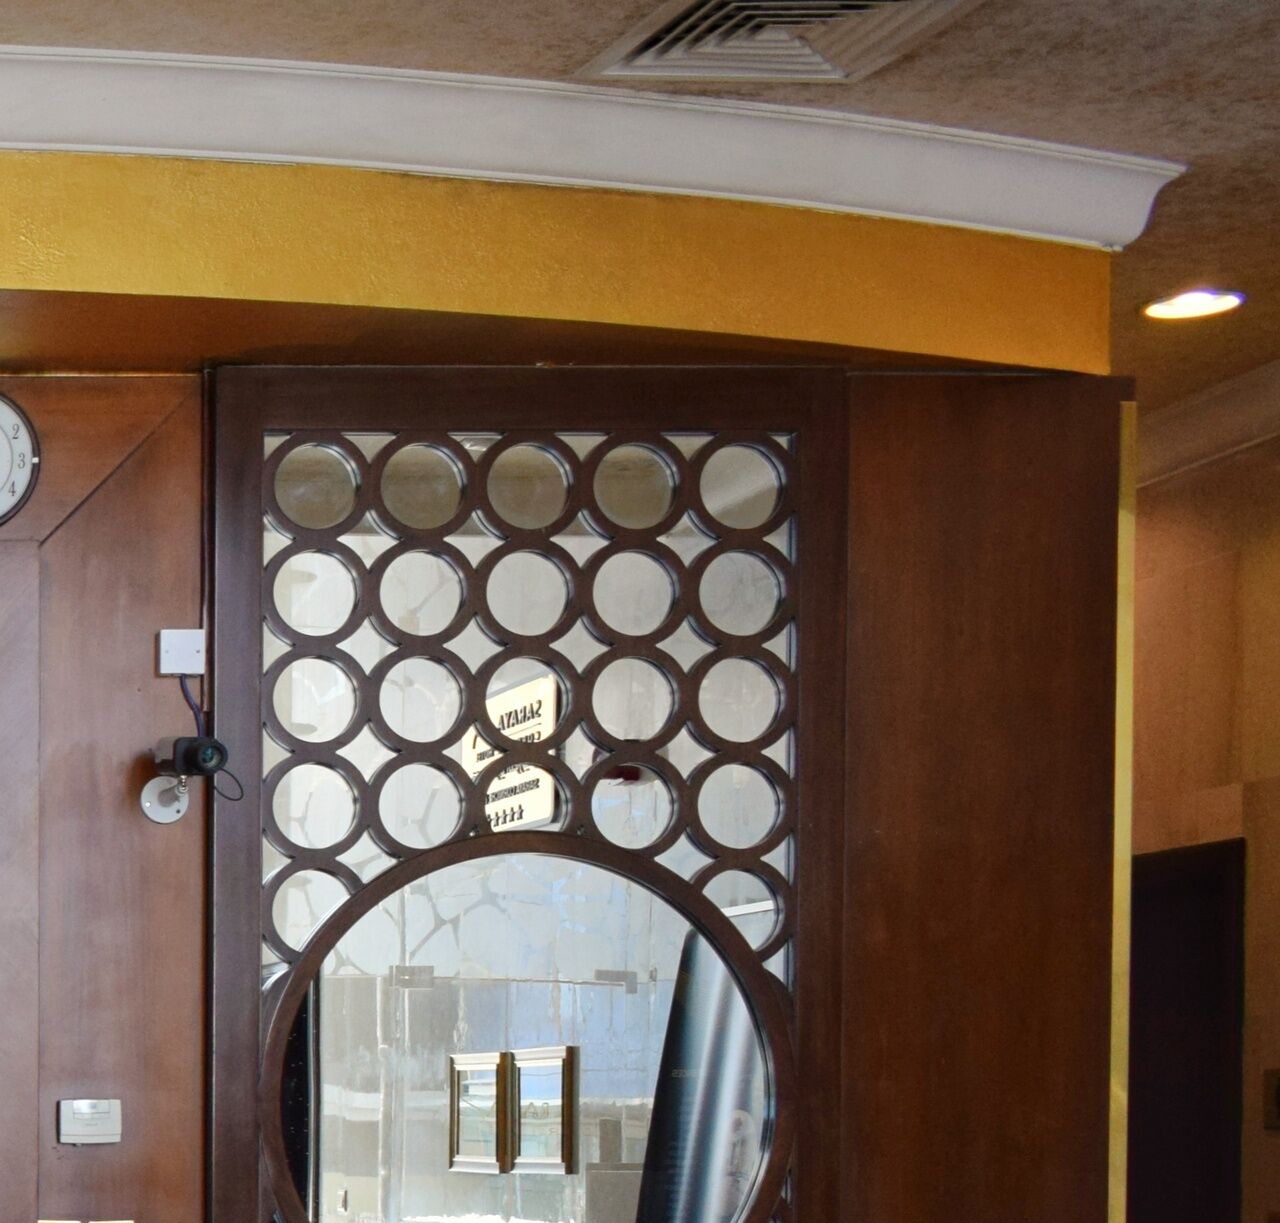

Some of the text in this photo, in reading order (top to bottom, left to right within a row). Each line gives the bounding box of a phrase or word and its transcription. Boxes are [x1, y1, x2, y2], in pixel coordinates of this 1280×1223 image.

[12, 424, 20, 439] 2
[18, 453, 25, 468] 3
[8, 481, 16, 496] 4
